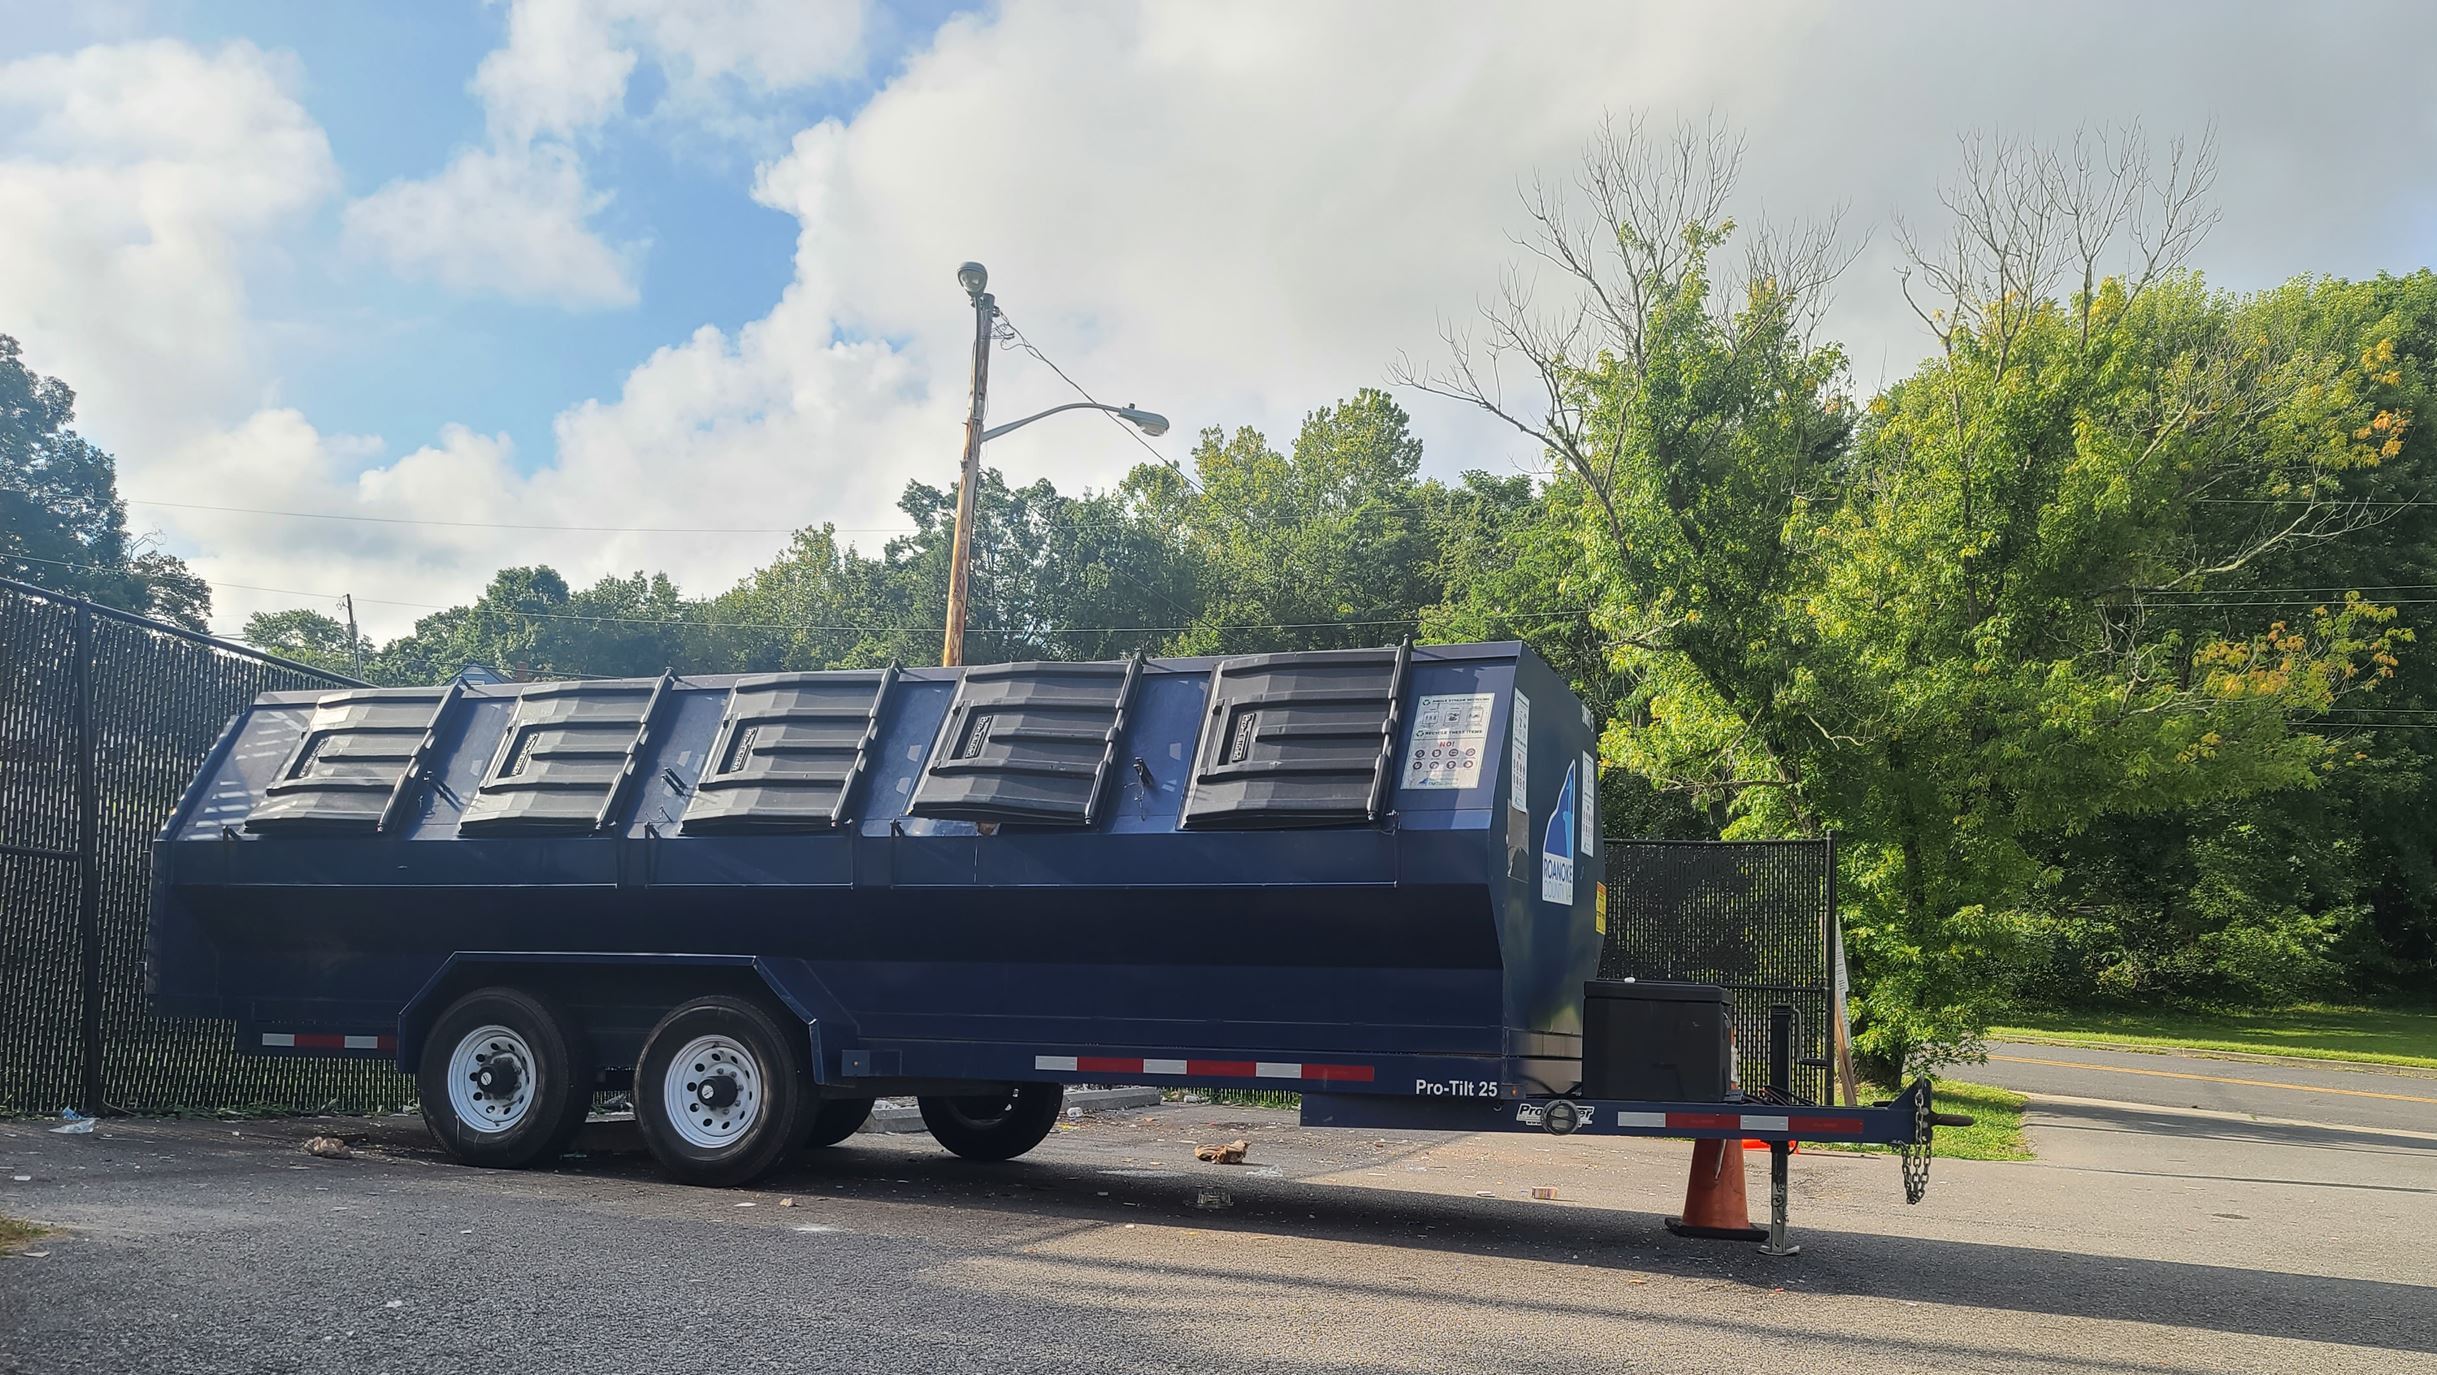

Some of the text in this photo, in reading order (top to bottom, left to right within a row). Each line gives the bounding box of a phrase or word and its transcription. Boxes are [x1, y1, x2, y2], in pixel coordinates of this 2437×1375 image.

[1543, 858, 1572, 883] ROANOKE
[1415, 1079, 1498, 1097] Pro-Tilt 25
